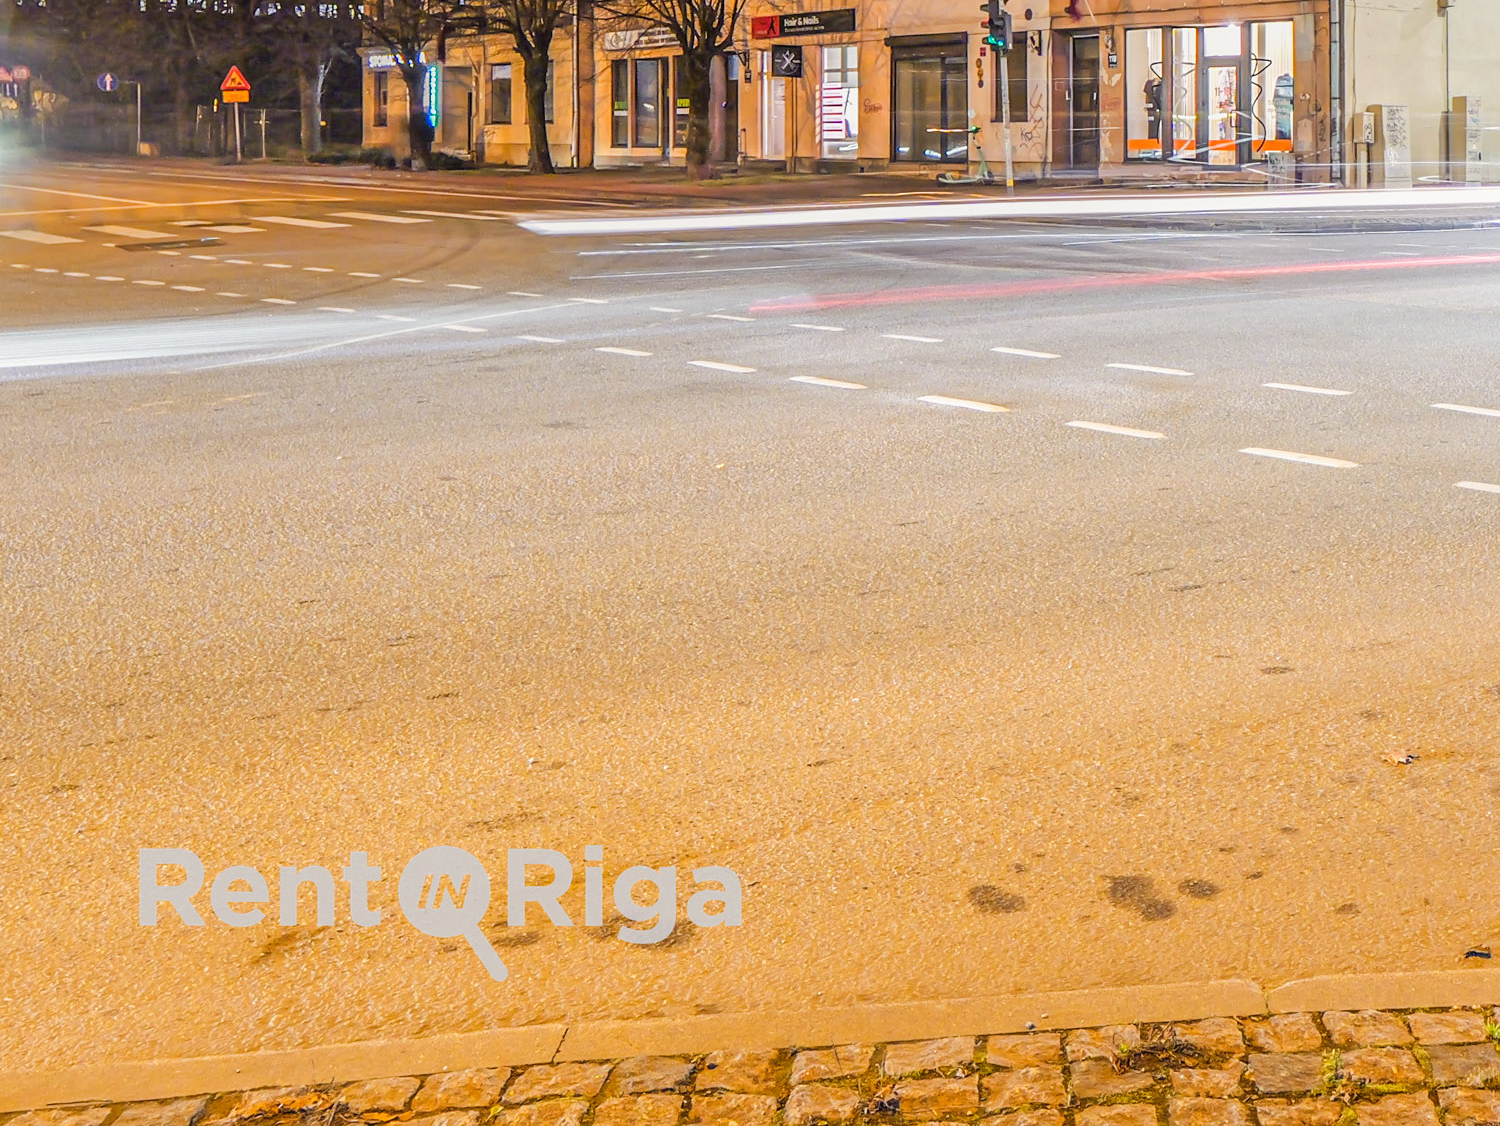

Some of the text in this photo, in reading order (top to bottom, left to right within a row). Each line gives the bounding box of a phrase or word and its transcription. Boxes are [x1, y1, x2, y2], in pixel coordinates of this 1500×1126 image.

[784, 15, 819, 27] Hair & Nails
